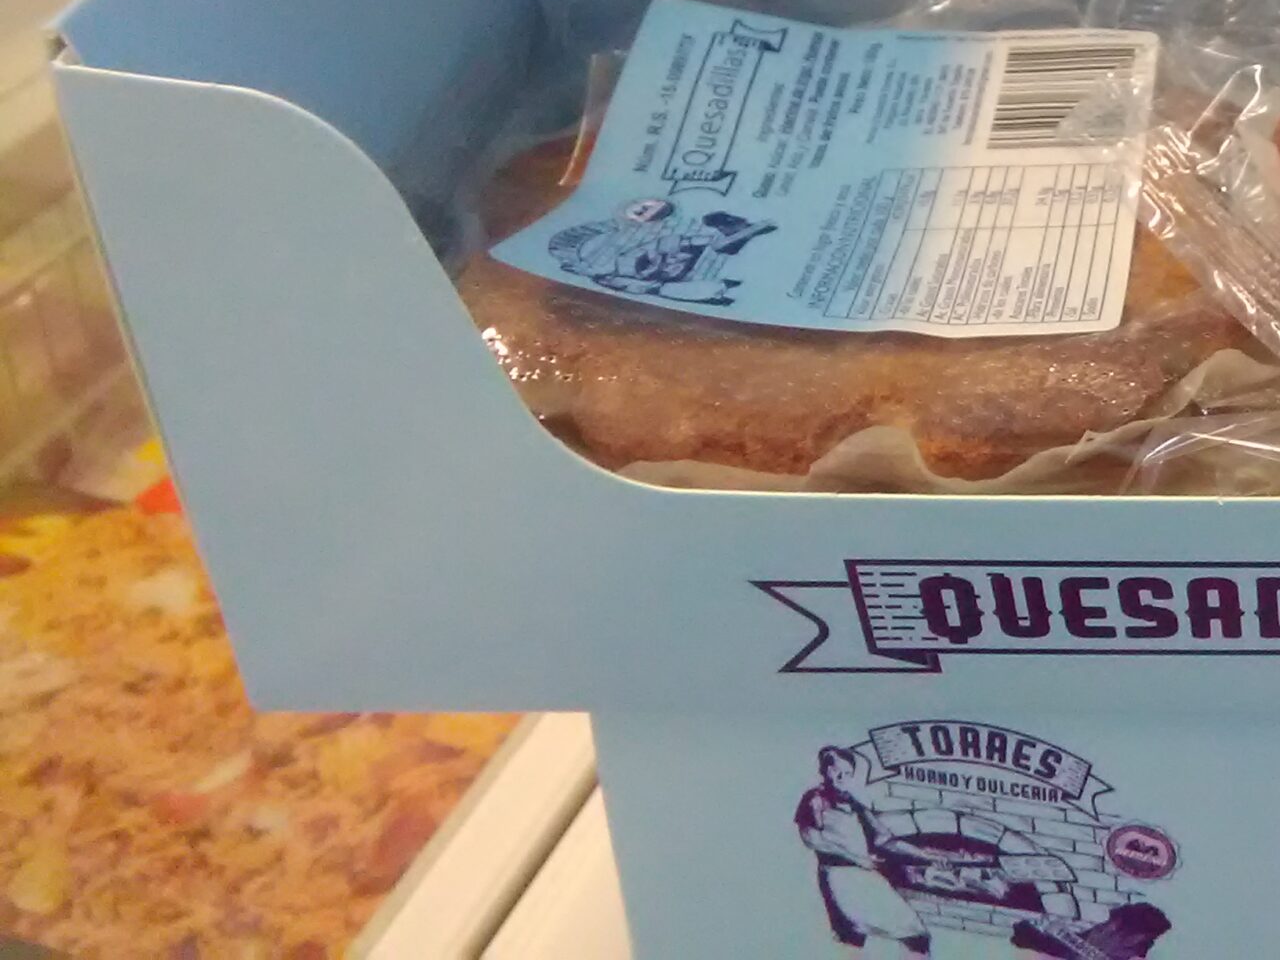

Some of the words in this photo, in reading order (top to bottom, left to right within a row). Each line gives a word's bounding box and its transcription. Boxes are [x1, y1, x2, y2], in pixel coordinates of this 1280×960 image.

[682, 46, 749, 166] Quesadillas
[901, 724, 1065, 781] TORRES
[903, 764, 962, 789] HORNO
[962, 773, 974, 791] Y
[975, 774, 1062, 804] DULCERIA
